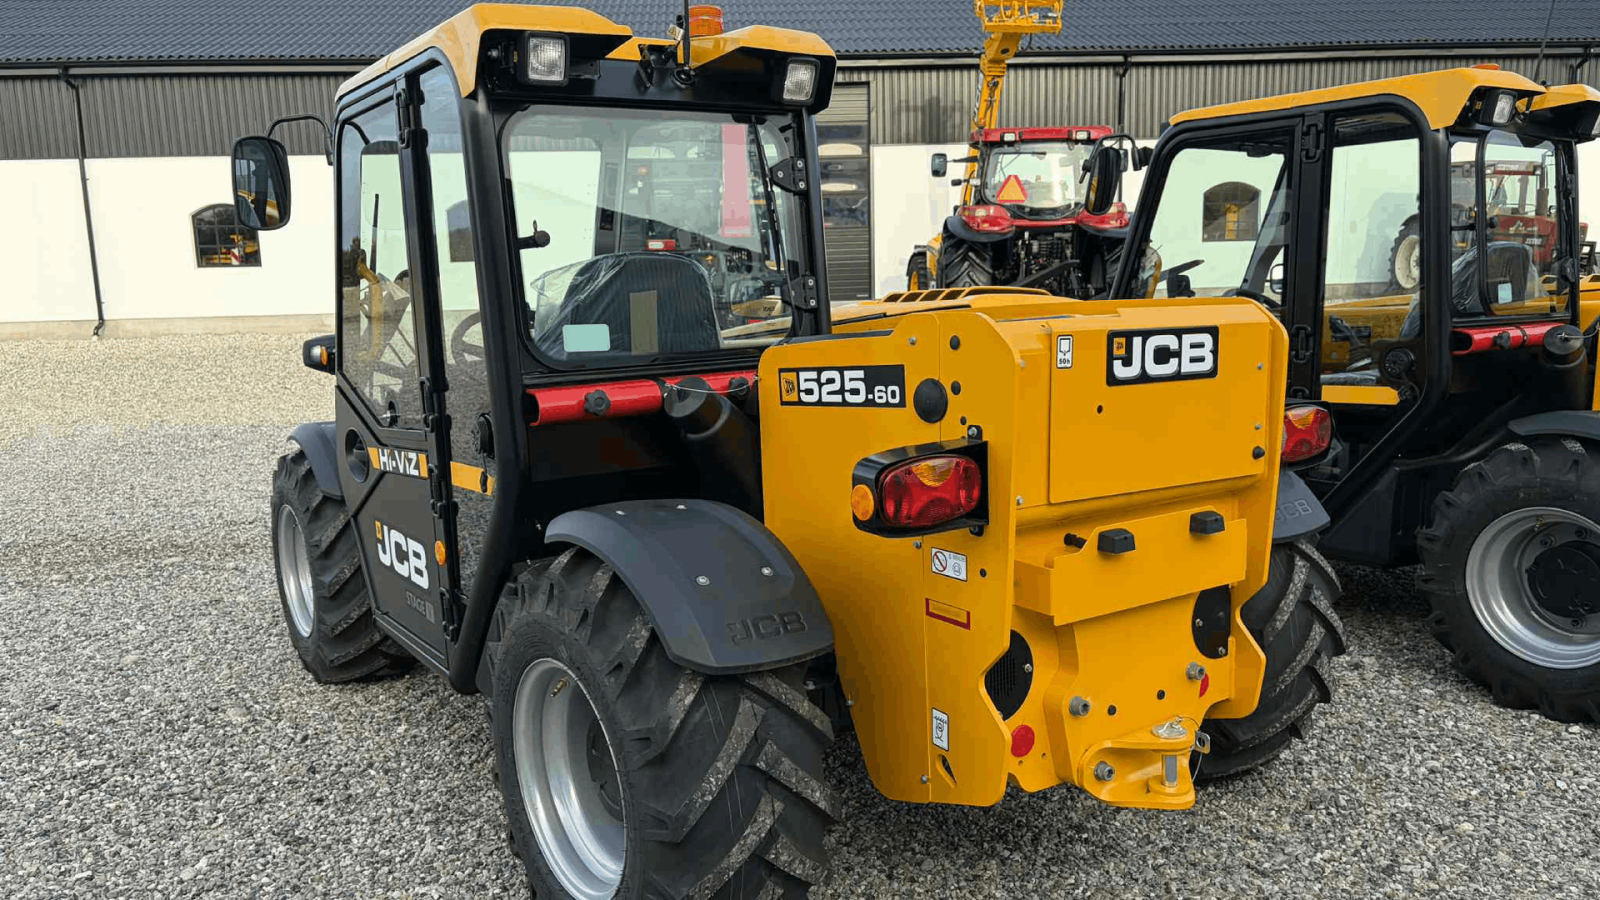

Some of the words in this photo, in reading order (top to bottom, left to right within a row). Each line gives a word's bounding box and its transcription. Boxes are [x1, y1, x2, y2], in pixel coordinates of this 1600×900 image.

[1113, 333, 1215, 380] JCB
[377, 524, 430, 590] JCB
[729, 610, 808, 645] JCB
